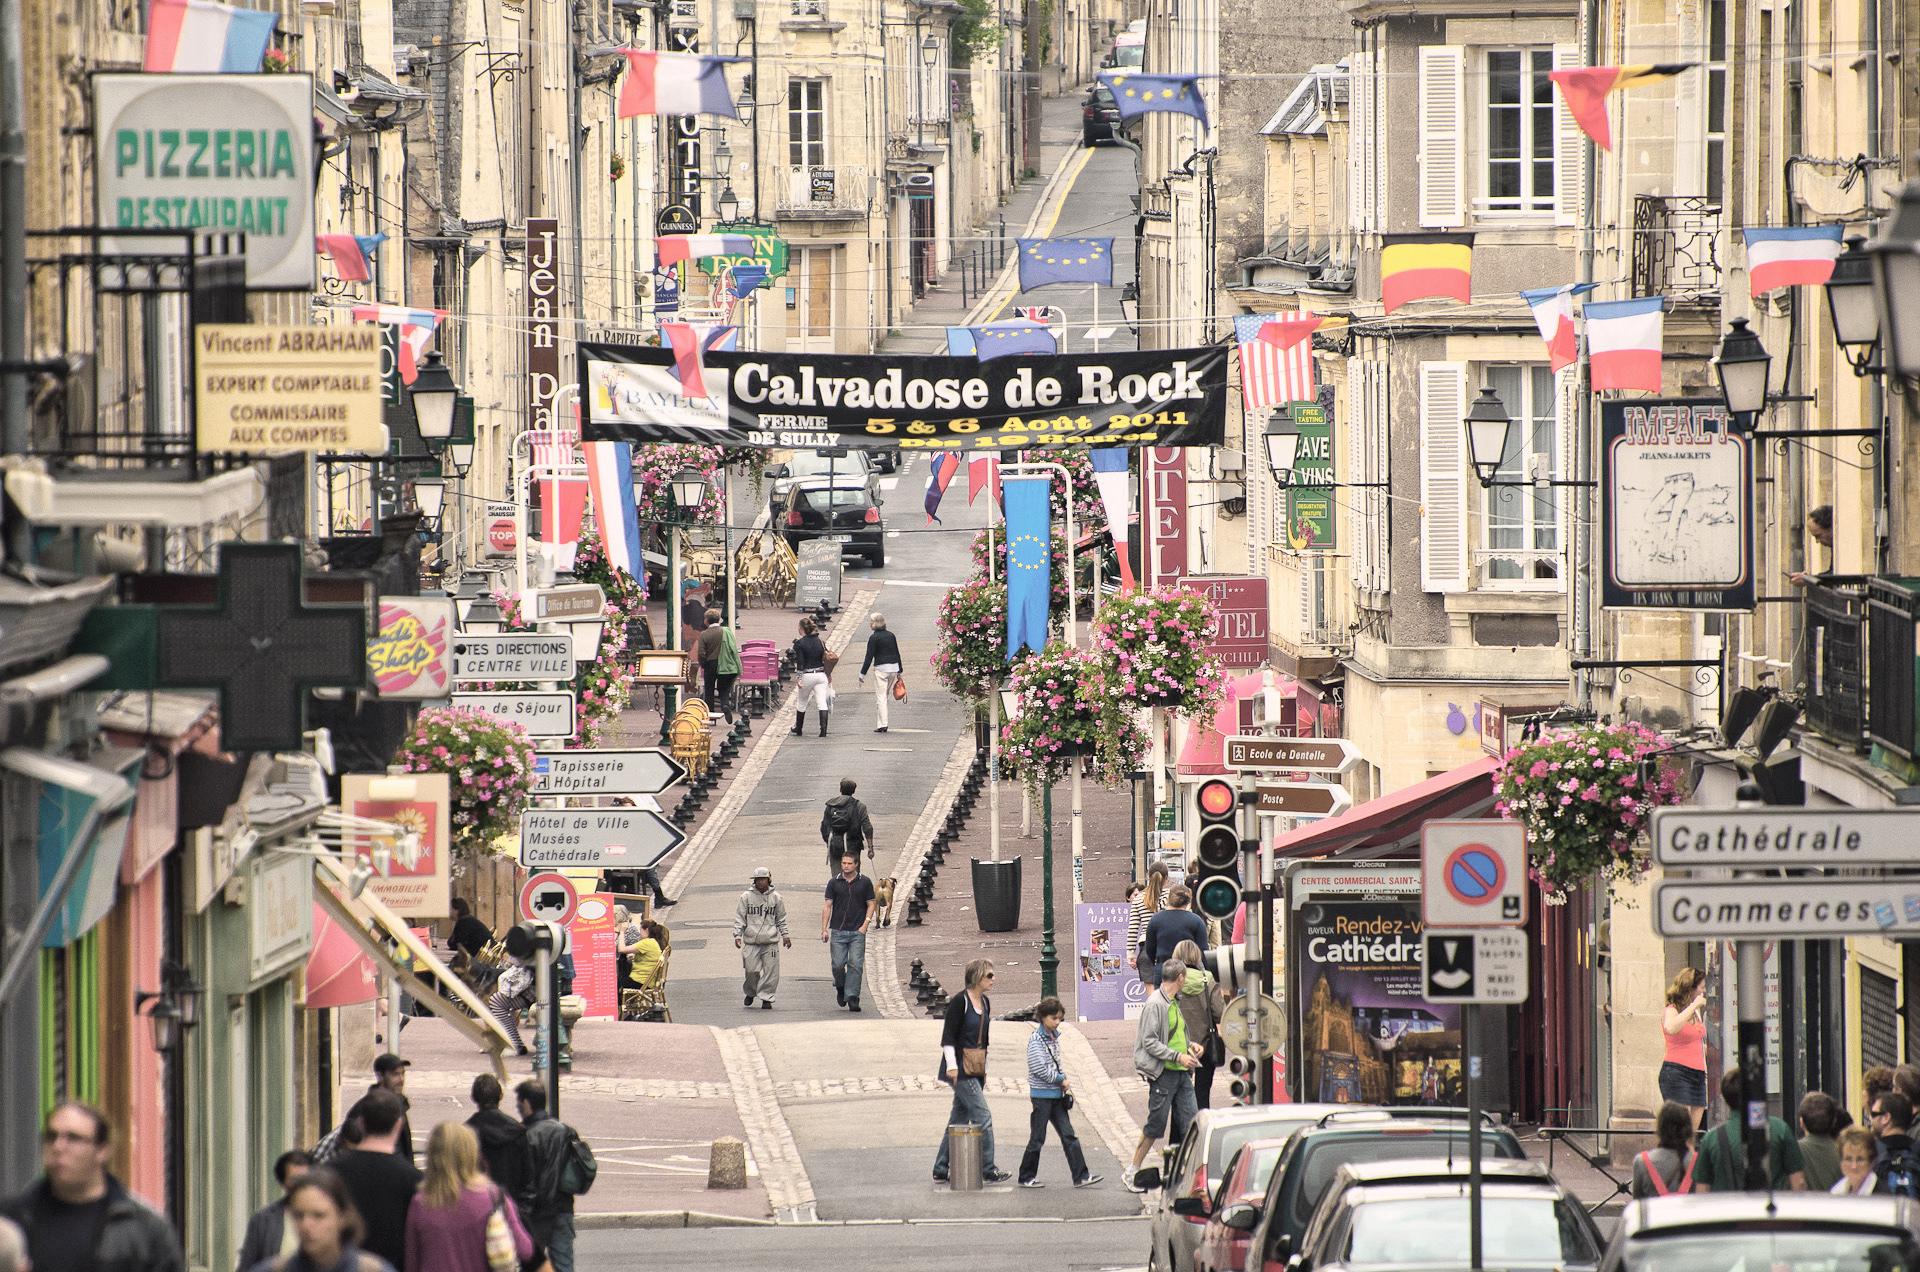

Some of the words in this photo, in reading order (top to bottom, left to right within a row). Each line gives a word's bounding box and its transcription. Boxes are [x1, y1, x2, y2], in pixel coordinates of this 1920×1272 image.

[116, 128, 295, 178] PIZZERIA
[117, 196, 288, 235] RESTAURANT
[660, 222, 694, 231] GUINNESS
[529, 231, 556, 348] Jean
[202, 331, 273, 351] Vincent
[278, 330, 375, 351] ABRAHAM
[590, 333, 600, 344] LA
[206, 375, 267, 393] EXPERT
[271, 374, 372, 392] COMPTABLE
[733, 362, 989, 409] Calvadose
[1004, 368, 1062, 408] de
[1077, 361, 1206, 404] Rock
[626, 389, 720, 411] BAYEUX
[230, 404, 347, 422] COMMISSAIRE
[758, 414, 828, 430] FERME
[865, 418, 897, 433] 5
[906, 420, 936, 434] &
[948, 418, 980, 433] 6
[998, 416, 1093, 433] Août
[1109, 411, 1189, 430] 2011
[1624, 406, 1734, 445] IMPACT
[230, 427, 264, 443] AUX
[270, 427, 347, 443] COMPTES
[748, 431, 776, 445] DE
[779, 432, 840, 447] SULLY
[975, 435, 1030, 447] 19
[1037, 432, 1158, 445] Heures
[1301, 467, 1334, 489] VINS
[1146, 446, 1182, 577] OTEL
[546, 598, 562, 612] Office
[564, 599, 571, 610] de
[572, 597, 593, 610] Tourisme
[368, 641, 430, 673] Shop
[496, 643, 567, 655] DIRECTIONS
[467, 660, 522, 672] CENTRE
[530, 660, 568, 672] VILLE
[493, 702, 508, 713] de
[515, 702, 562, 716] Séjour
[1250, 749, 1273, 760] Ecole
[1276, 750, 1287, 760] de
[1289, 750, 1326, 761] Dentelle
[553, 760, 624, 773] Tapisserie
[554, 776, 606, 790] Hôpital
[1262, 793, 1284, 805] Poste
[529, 816, 565, 829] Hôtel
[573, 817, 588, 829] de
[597, 817, 629, 829] Ville
[529, 832, 580, 845] Musées
[1671, 823, 1862, 851] Cathédrale
[529, 848, 600, 861] Cathédrale
[371, 884, 429, 894] IMMOBILIER
[1301, 877, 1331, 886] CENTRE
[1333, 877, 1386, 886] COMMERCIAL
[1087, 907, 1094, 915] A
[1101, 907, 1128, 915] l'éta
[1672, 897, 1871, 923] Commerces
[1090, 915, 1129, 925] Upstai
[1308, 926, 1335, 935] BAYEUX
[1336, 915, 1425, 934] Rendez-v
[1308, 936, 1423, 963] Cathédra
